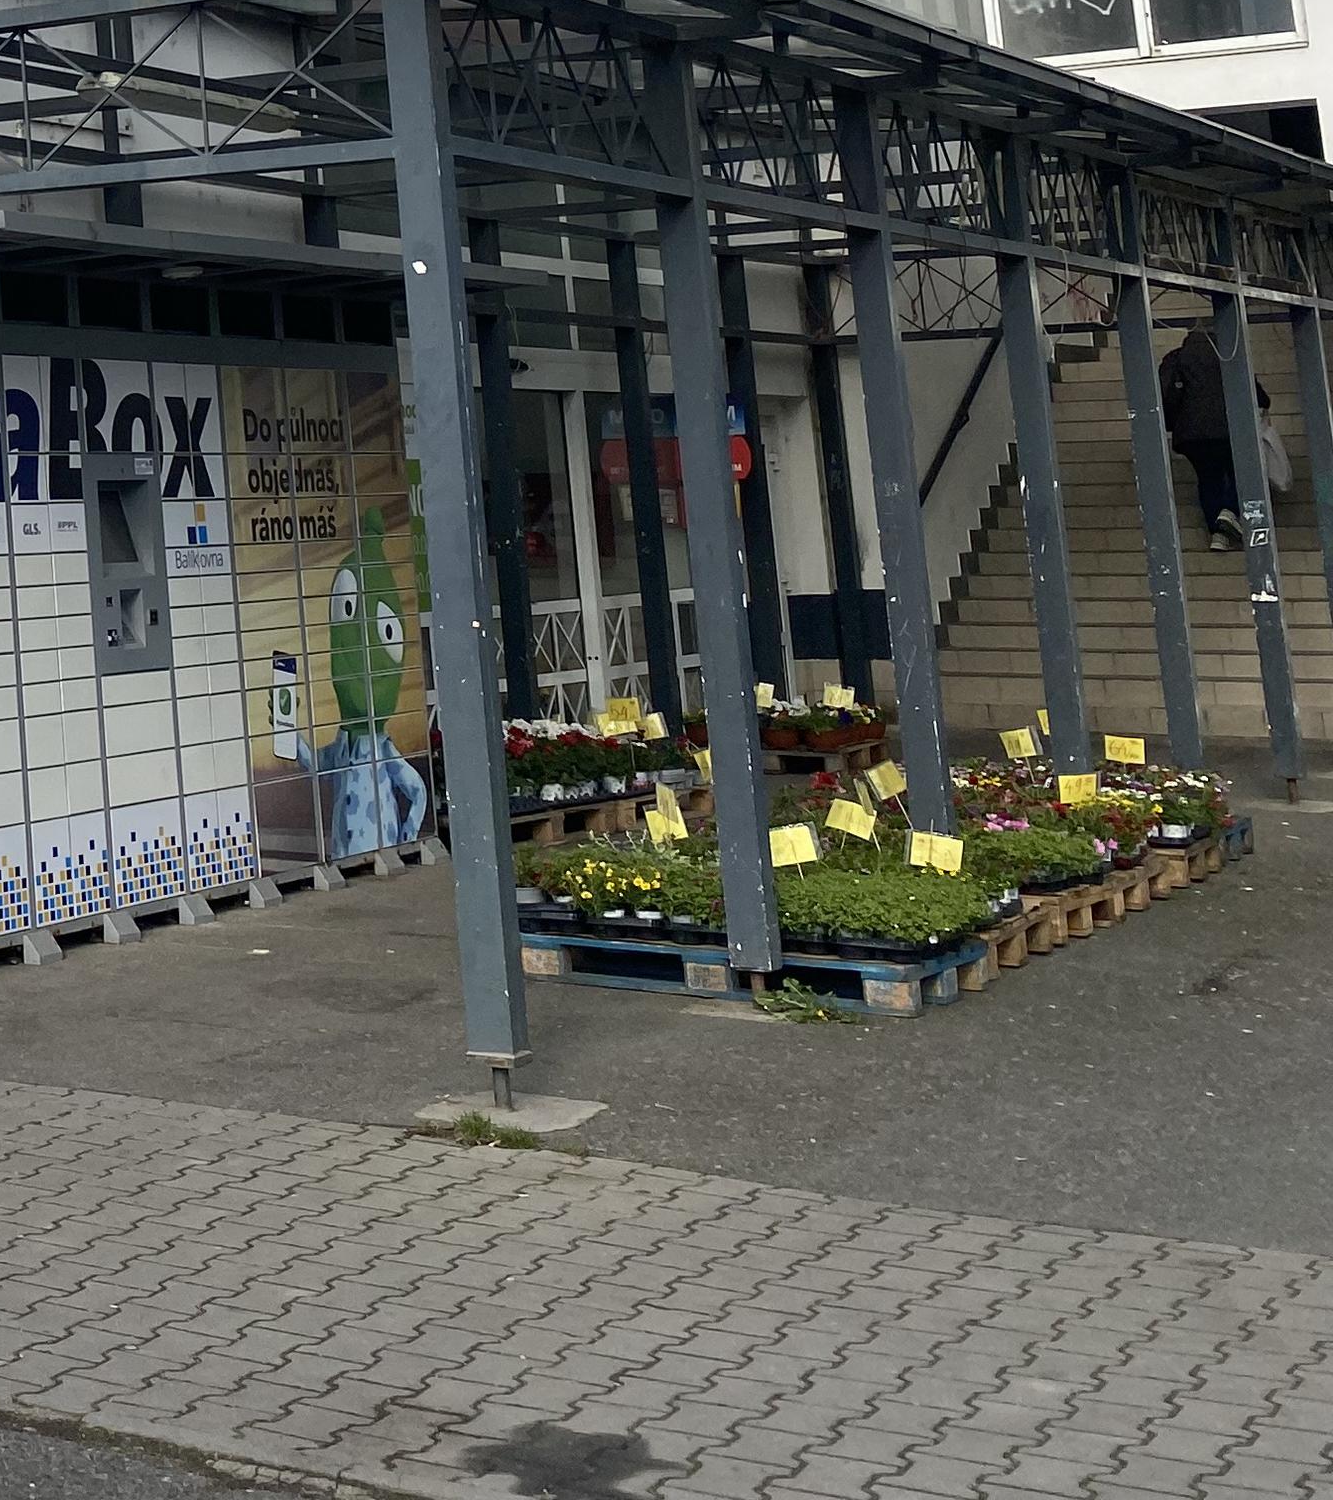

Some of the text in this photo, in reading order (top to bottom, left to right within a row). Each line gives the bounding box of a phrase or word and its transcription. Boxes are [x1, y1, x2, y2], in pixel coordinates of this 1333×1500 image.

[242, 406, 344, 453] Do půlnoci
[247, 458, 341, 505] objednáš,
[251, 505, 337, 542] ráno máš
